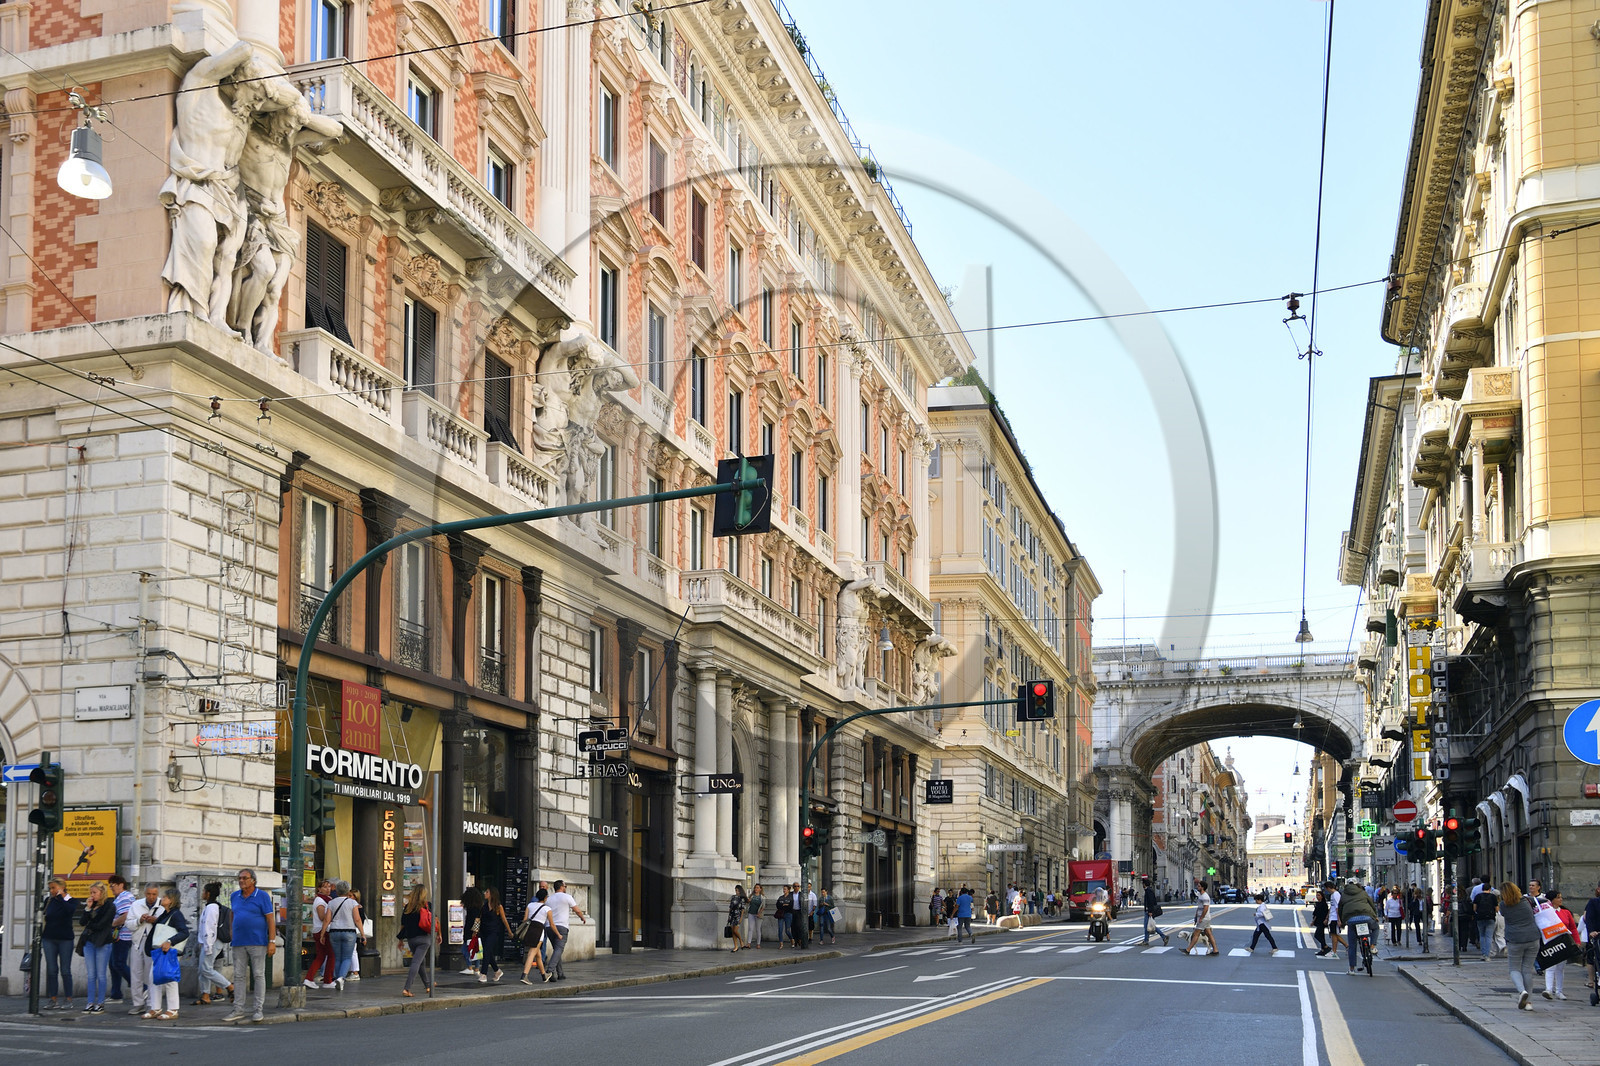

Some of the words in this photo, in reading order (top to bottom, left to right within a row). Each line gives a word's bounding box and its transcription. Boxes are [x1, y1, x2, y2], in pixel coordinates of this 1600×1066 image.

[346, 686, 359, 695] 1919
[364, 690, 378, 701] 2019
[346, 699, 378, 728] 100
[1408, 646, 1433, 780] HOTEL
[345, 728, 377, 751] anni
[585, 742, 627, 751] PASCUCCI
[307, 743, 423, 789] FORMENTO
[341, 784, 382, 800] IMMOBILIARI
[383, 791, 395, 802] DAL
[396, 793, 411, 804] 1919
[463, 820, 502, 838] PASCUCCI
[504, 826, 519, 840] BIO
[598, 824, 619, 838] LOVE
[382, 810, 395, 891] FORMENTO
[1541, 942, 1567, 958] upim
